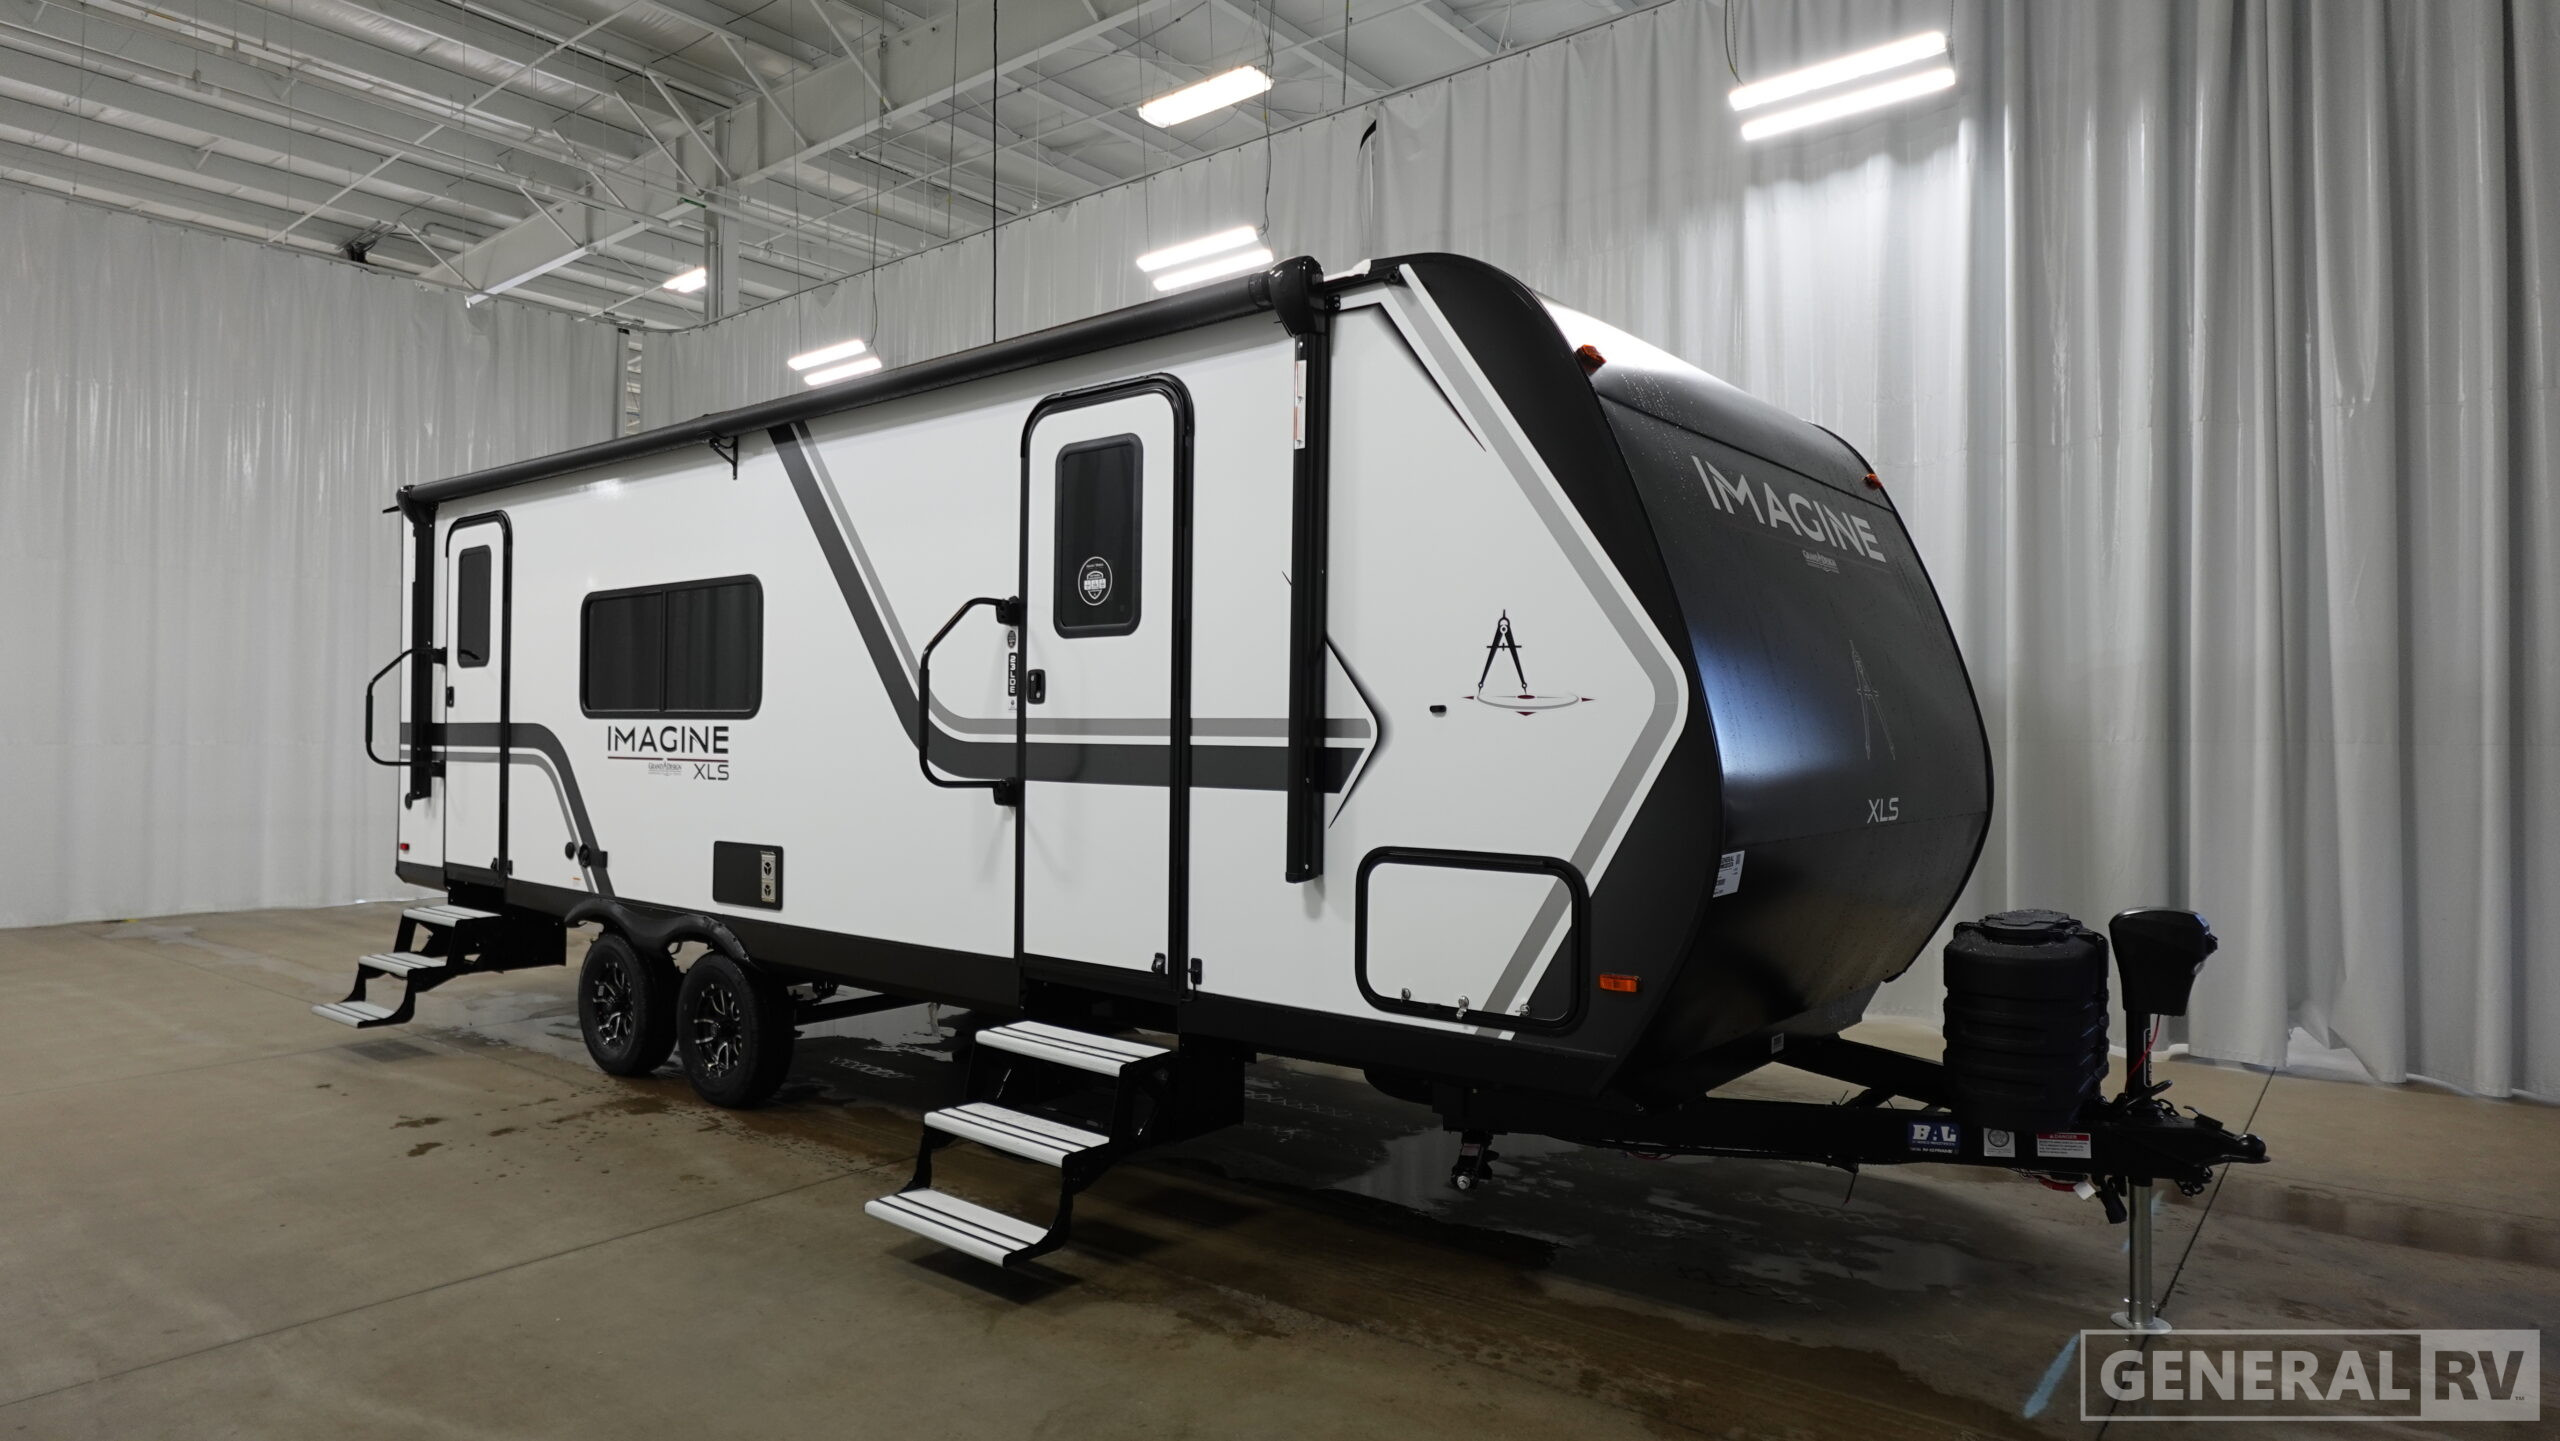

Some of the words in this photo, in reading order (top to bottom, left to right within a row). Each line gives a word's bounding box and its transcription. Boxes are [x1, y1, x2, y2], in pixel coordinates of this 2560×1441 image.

[1692, 455, 1886, 563] IMAGINE
[608, 726, 729, 754] IMAGINE
[694, 763, 730, 781] XLS
[1867, 797, 1899, 824] XLS
